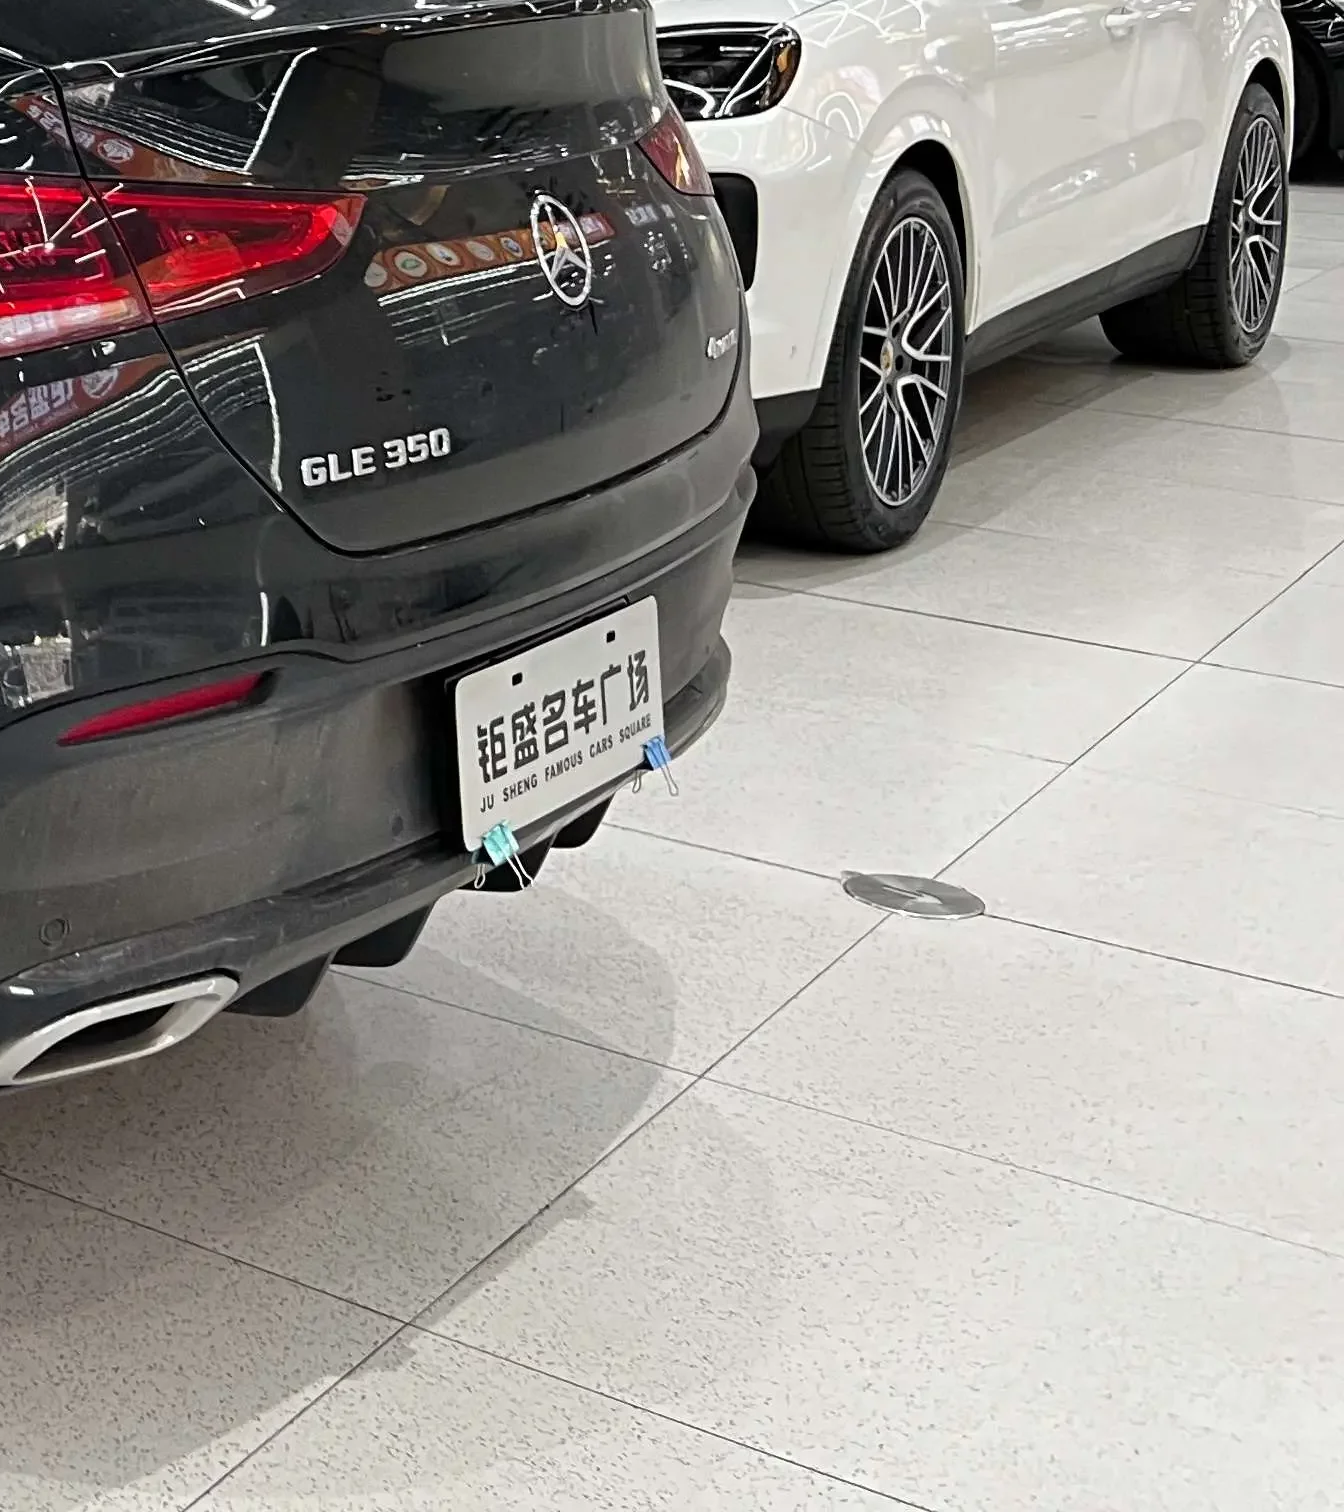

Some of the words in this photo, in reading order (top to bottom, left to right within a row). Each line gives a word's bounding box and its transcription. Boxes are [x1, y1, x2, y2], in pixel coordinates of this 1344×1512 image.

[301, 447, 376, 486] GLE
[384, 428, 451, 468] 350
[477, 650, 649, 783] 钜盛名车广场
[480, 794, 494, 812] JU
[503, 774, 538, 802] SHENG
[545, 750, 583, 781] FAMOUS
[589, 734, 614, 758] CARS
[619, 713, 652, 743] SQUARE
